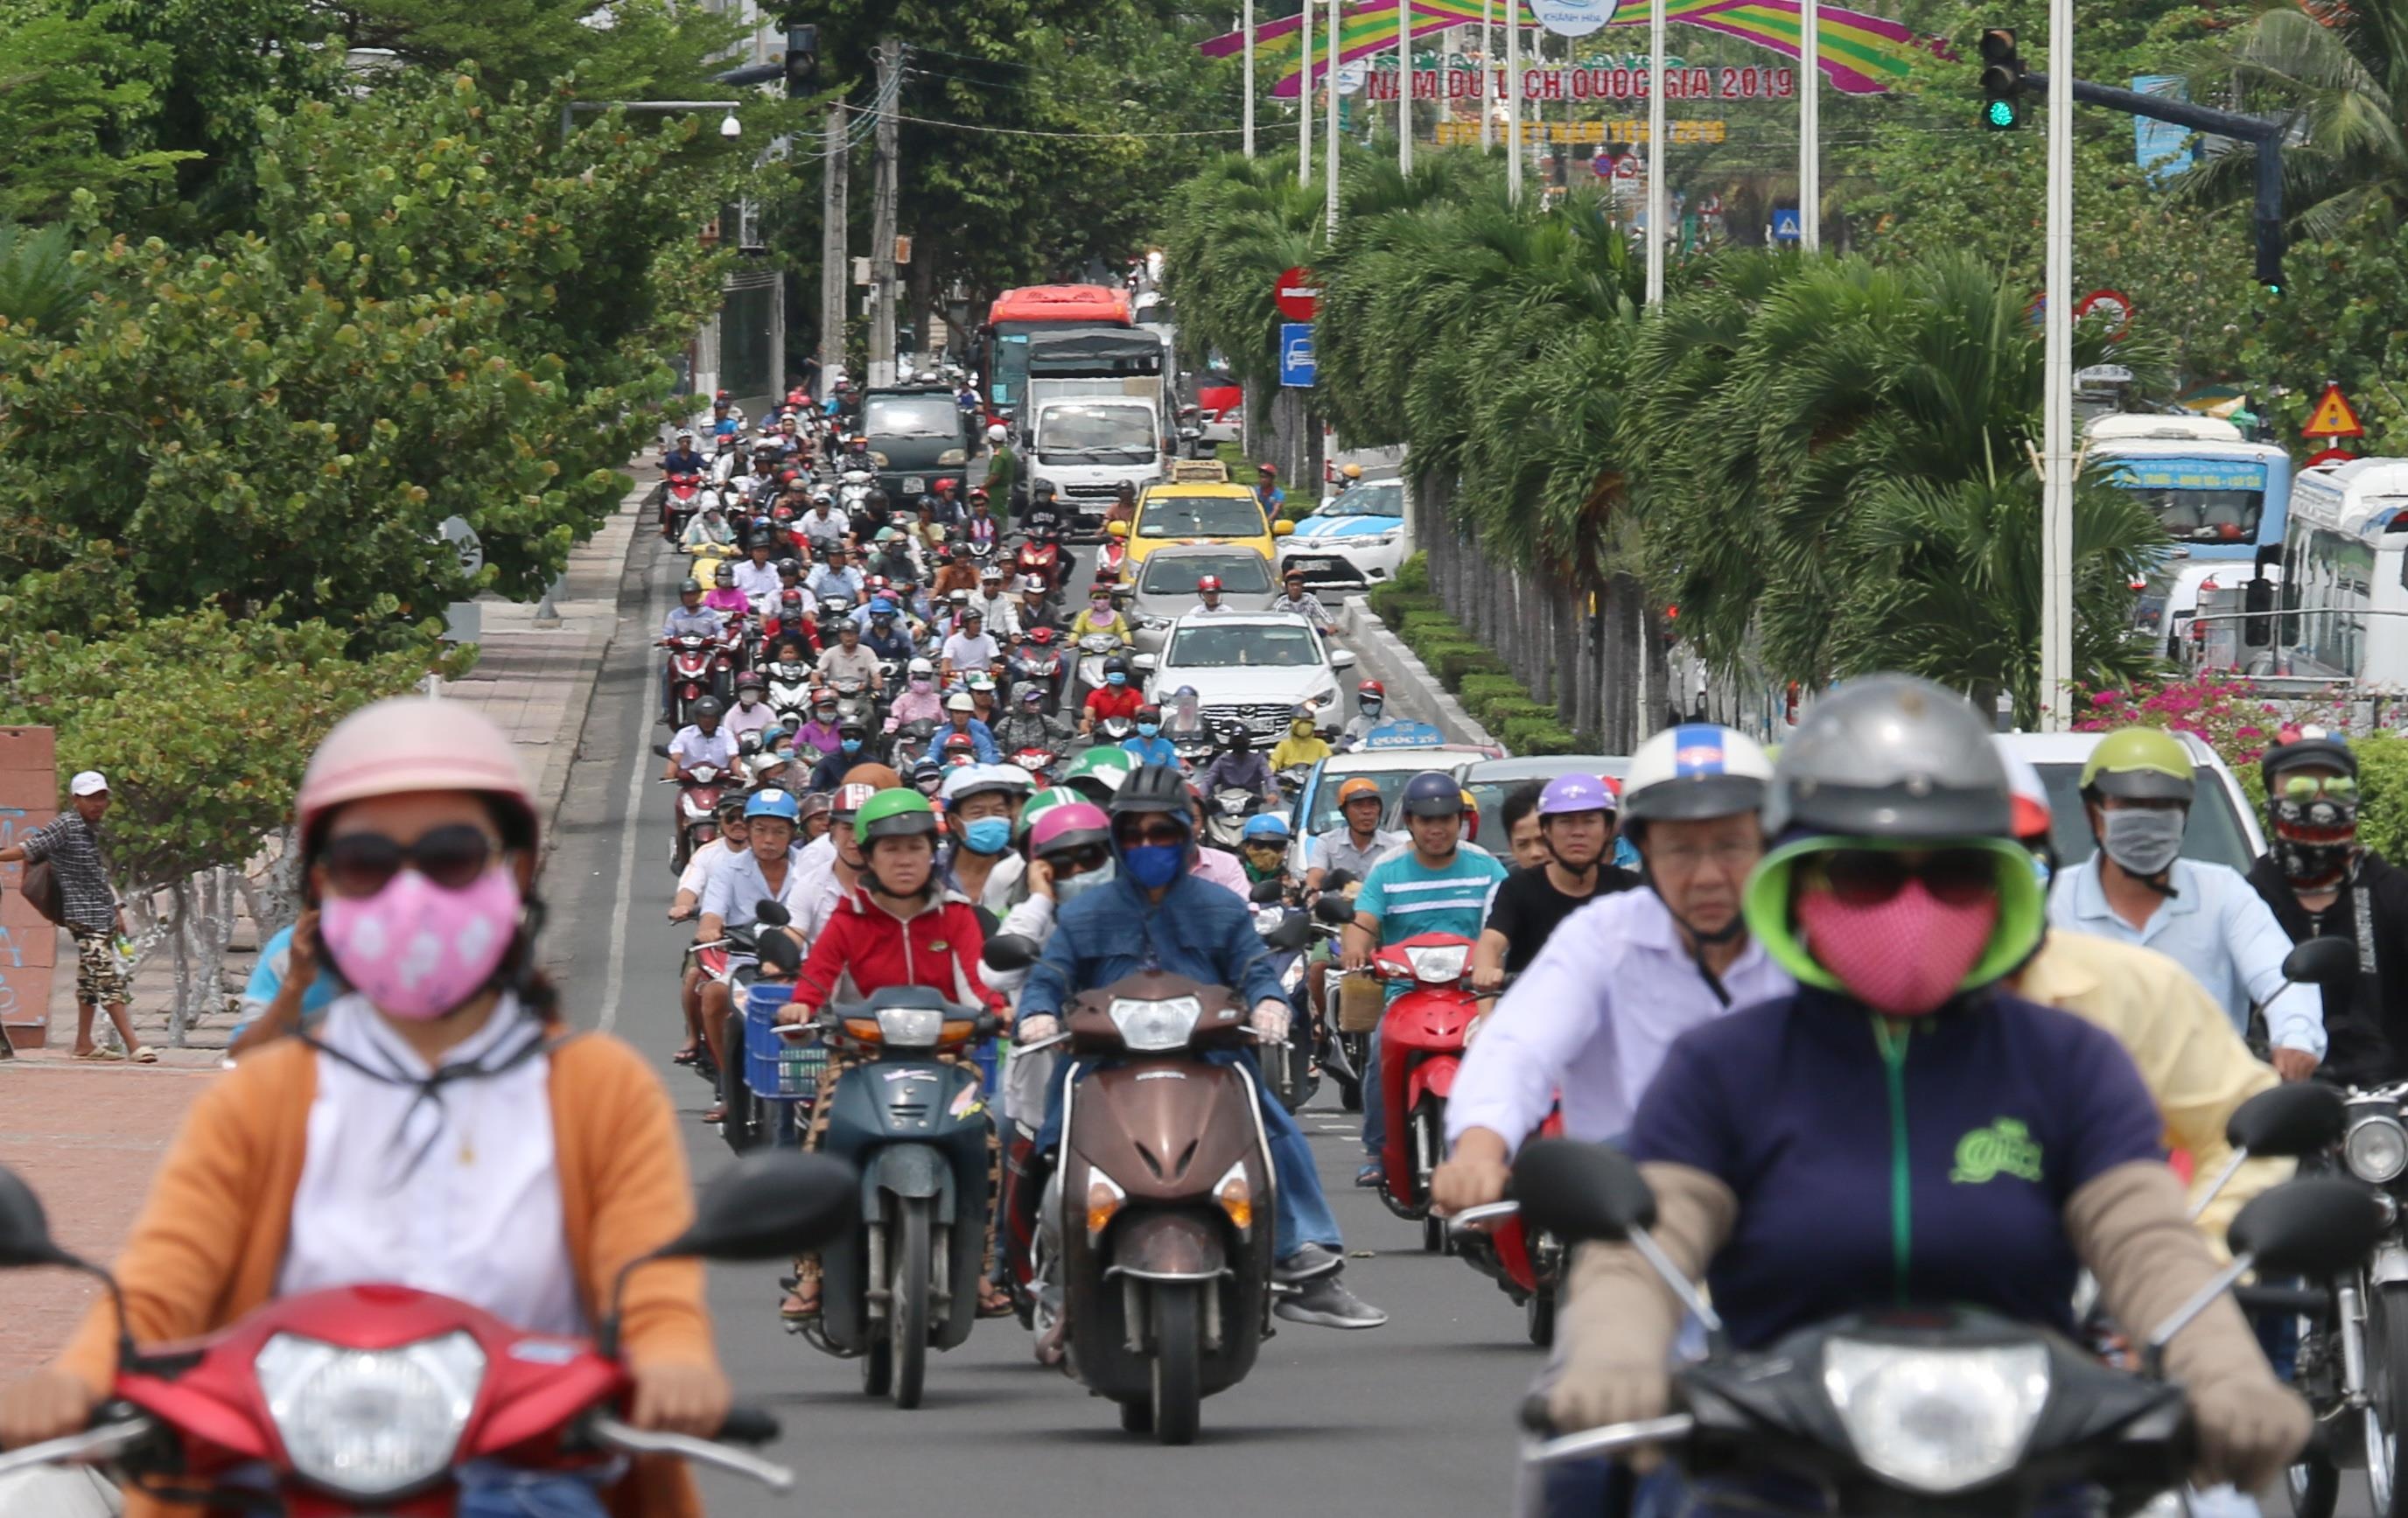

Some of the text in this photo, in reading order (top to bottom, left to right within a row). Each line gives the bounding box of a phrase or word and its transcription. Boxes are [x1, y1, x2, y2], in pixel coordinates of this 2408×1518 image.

[1448, 68, 1485, 100] DU
[1497, 68, 1562, 100] LCH
[1663, 67, 1711, 99] GIA
[1721, 66, 1793, 99] 2019
